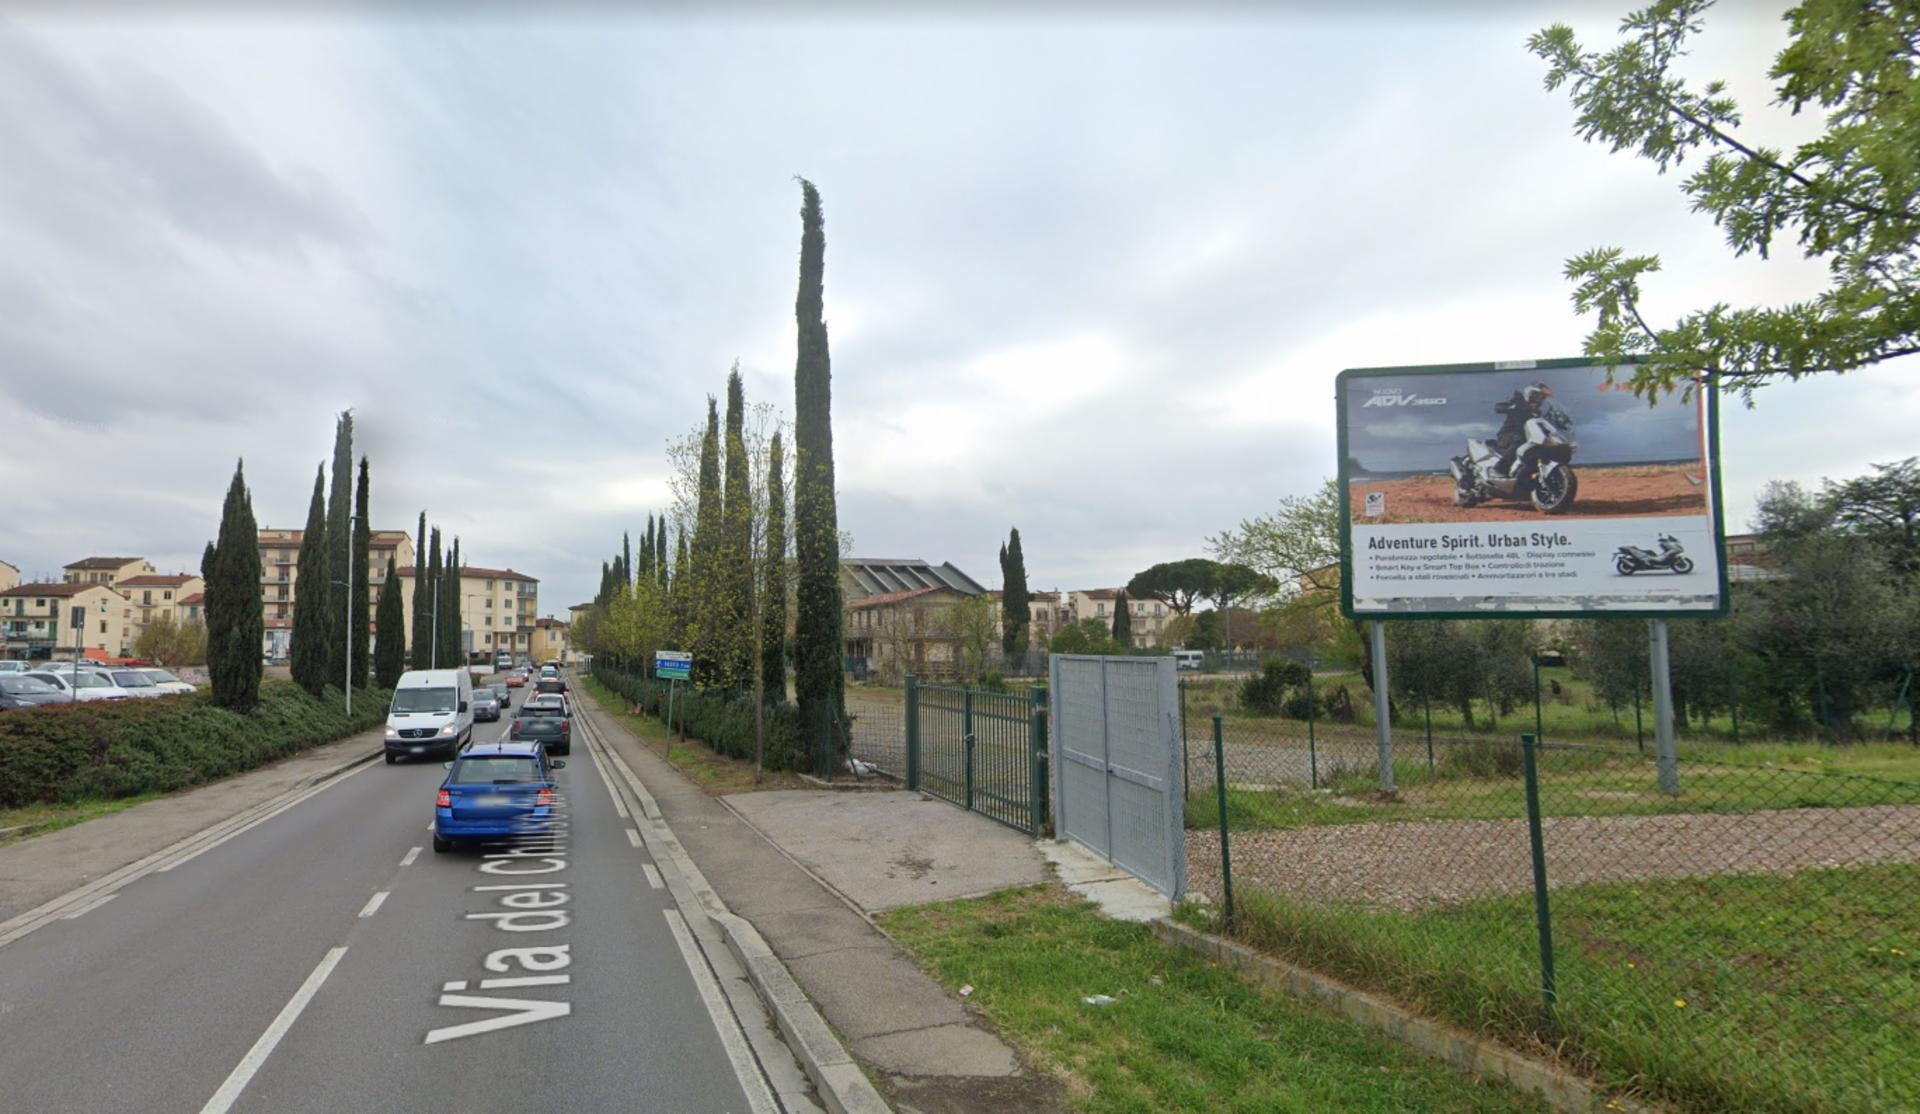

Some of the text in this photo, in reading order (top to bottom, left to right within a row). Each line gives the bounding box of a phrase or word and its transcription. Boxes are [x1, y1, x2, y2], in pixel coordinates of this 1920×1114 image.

[1368, 532, 1572, 551] Adventure Spirit. Urban Style.
